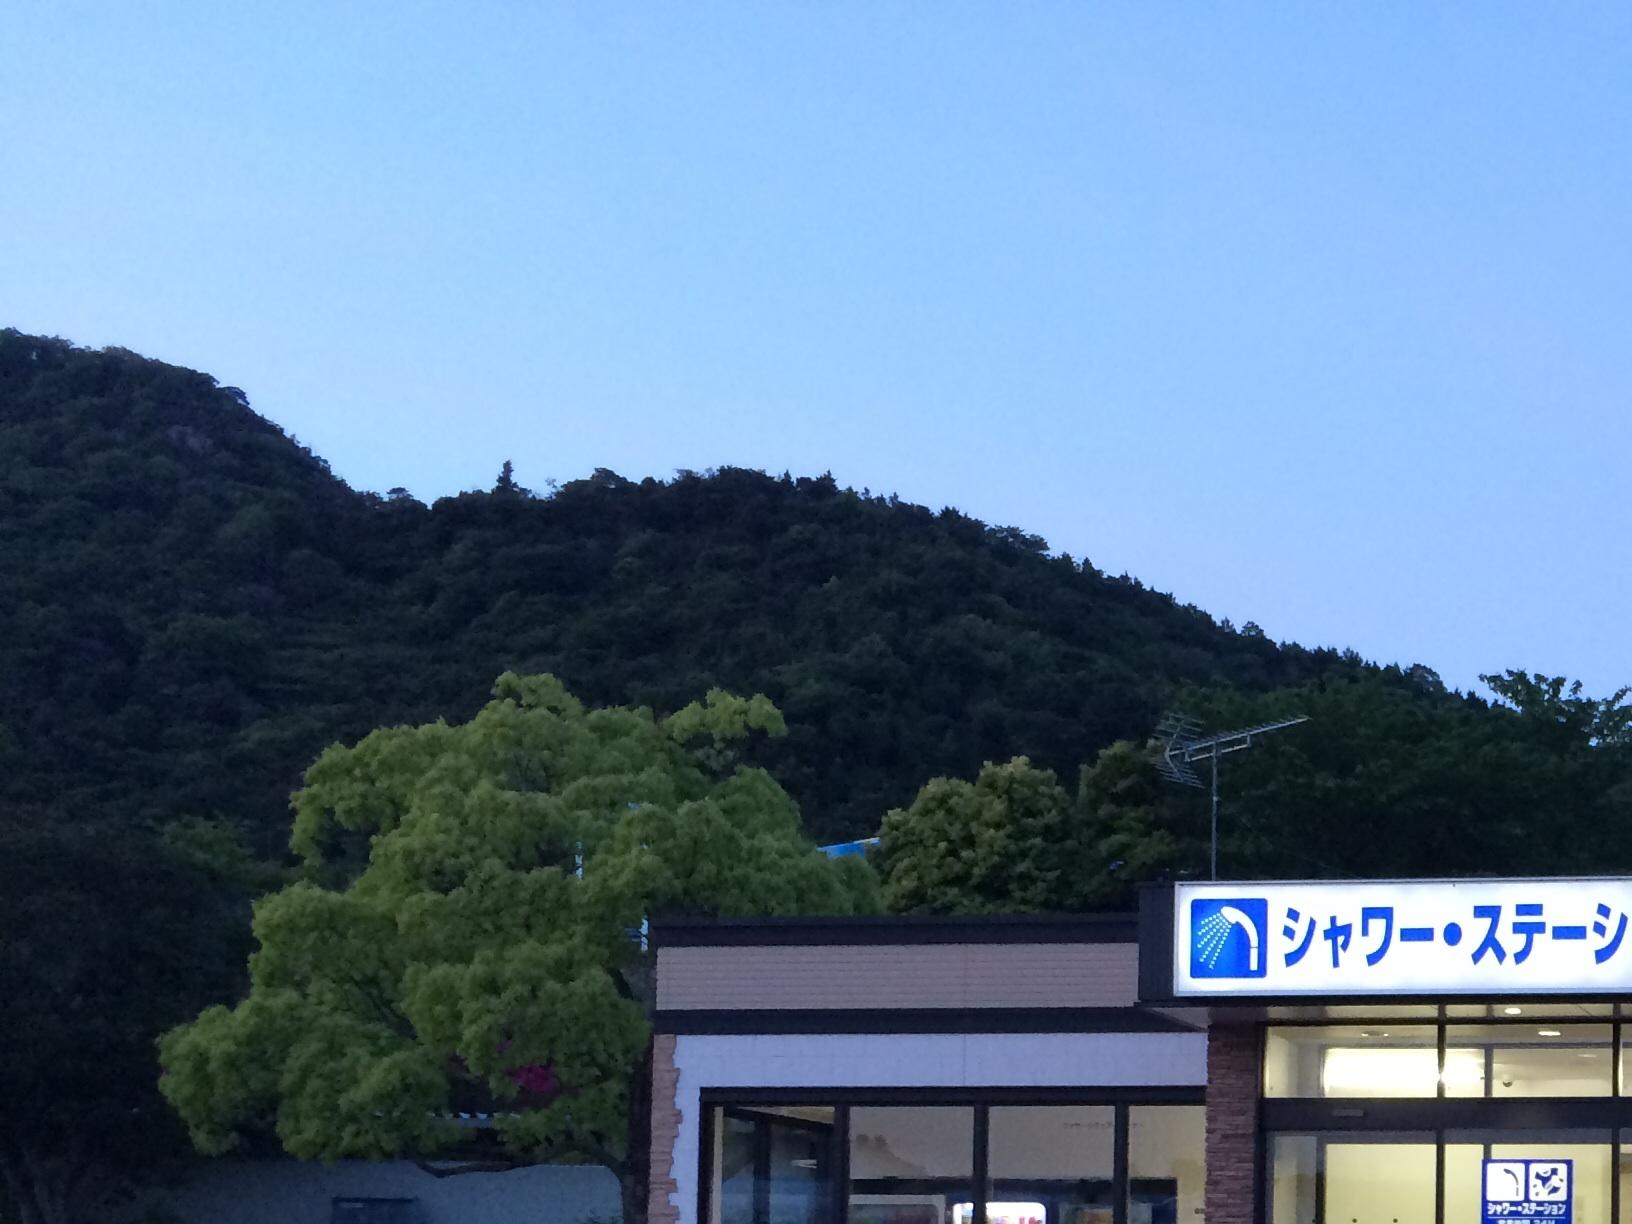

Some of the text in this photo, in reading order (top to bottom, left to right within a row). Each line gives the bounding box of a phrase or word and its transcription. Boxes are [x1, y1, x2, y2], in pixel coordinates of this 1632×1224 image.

[1487, 1202, 1566, 1215] シャワー・ステーション
